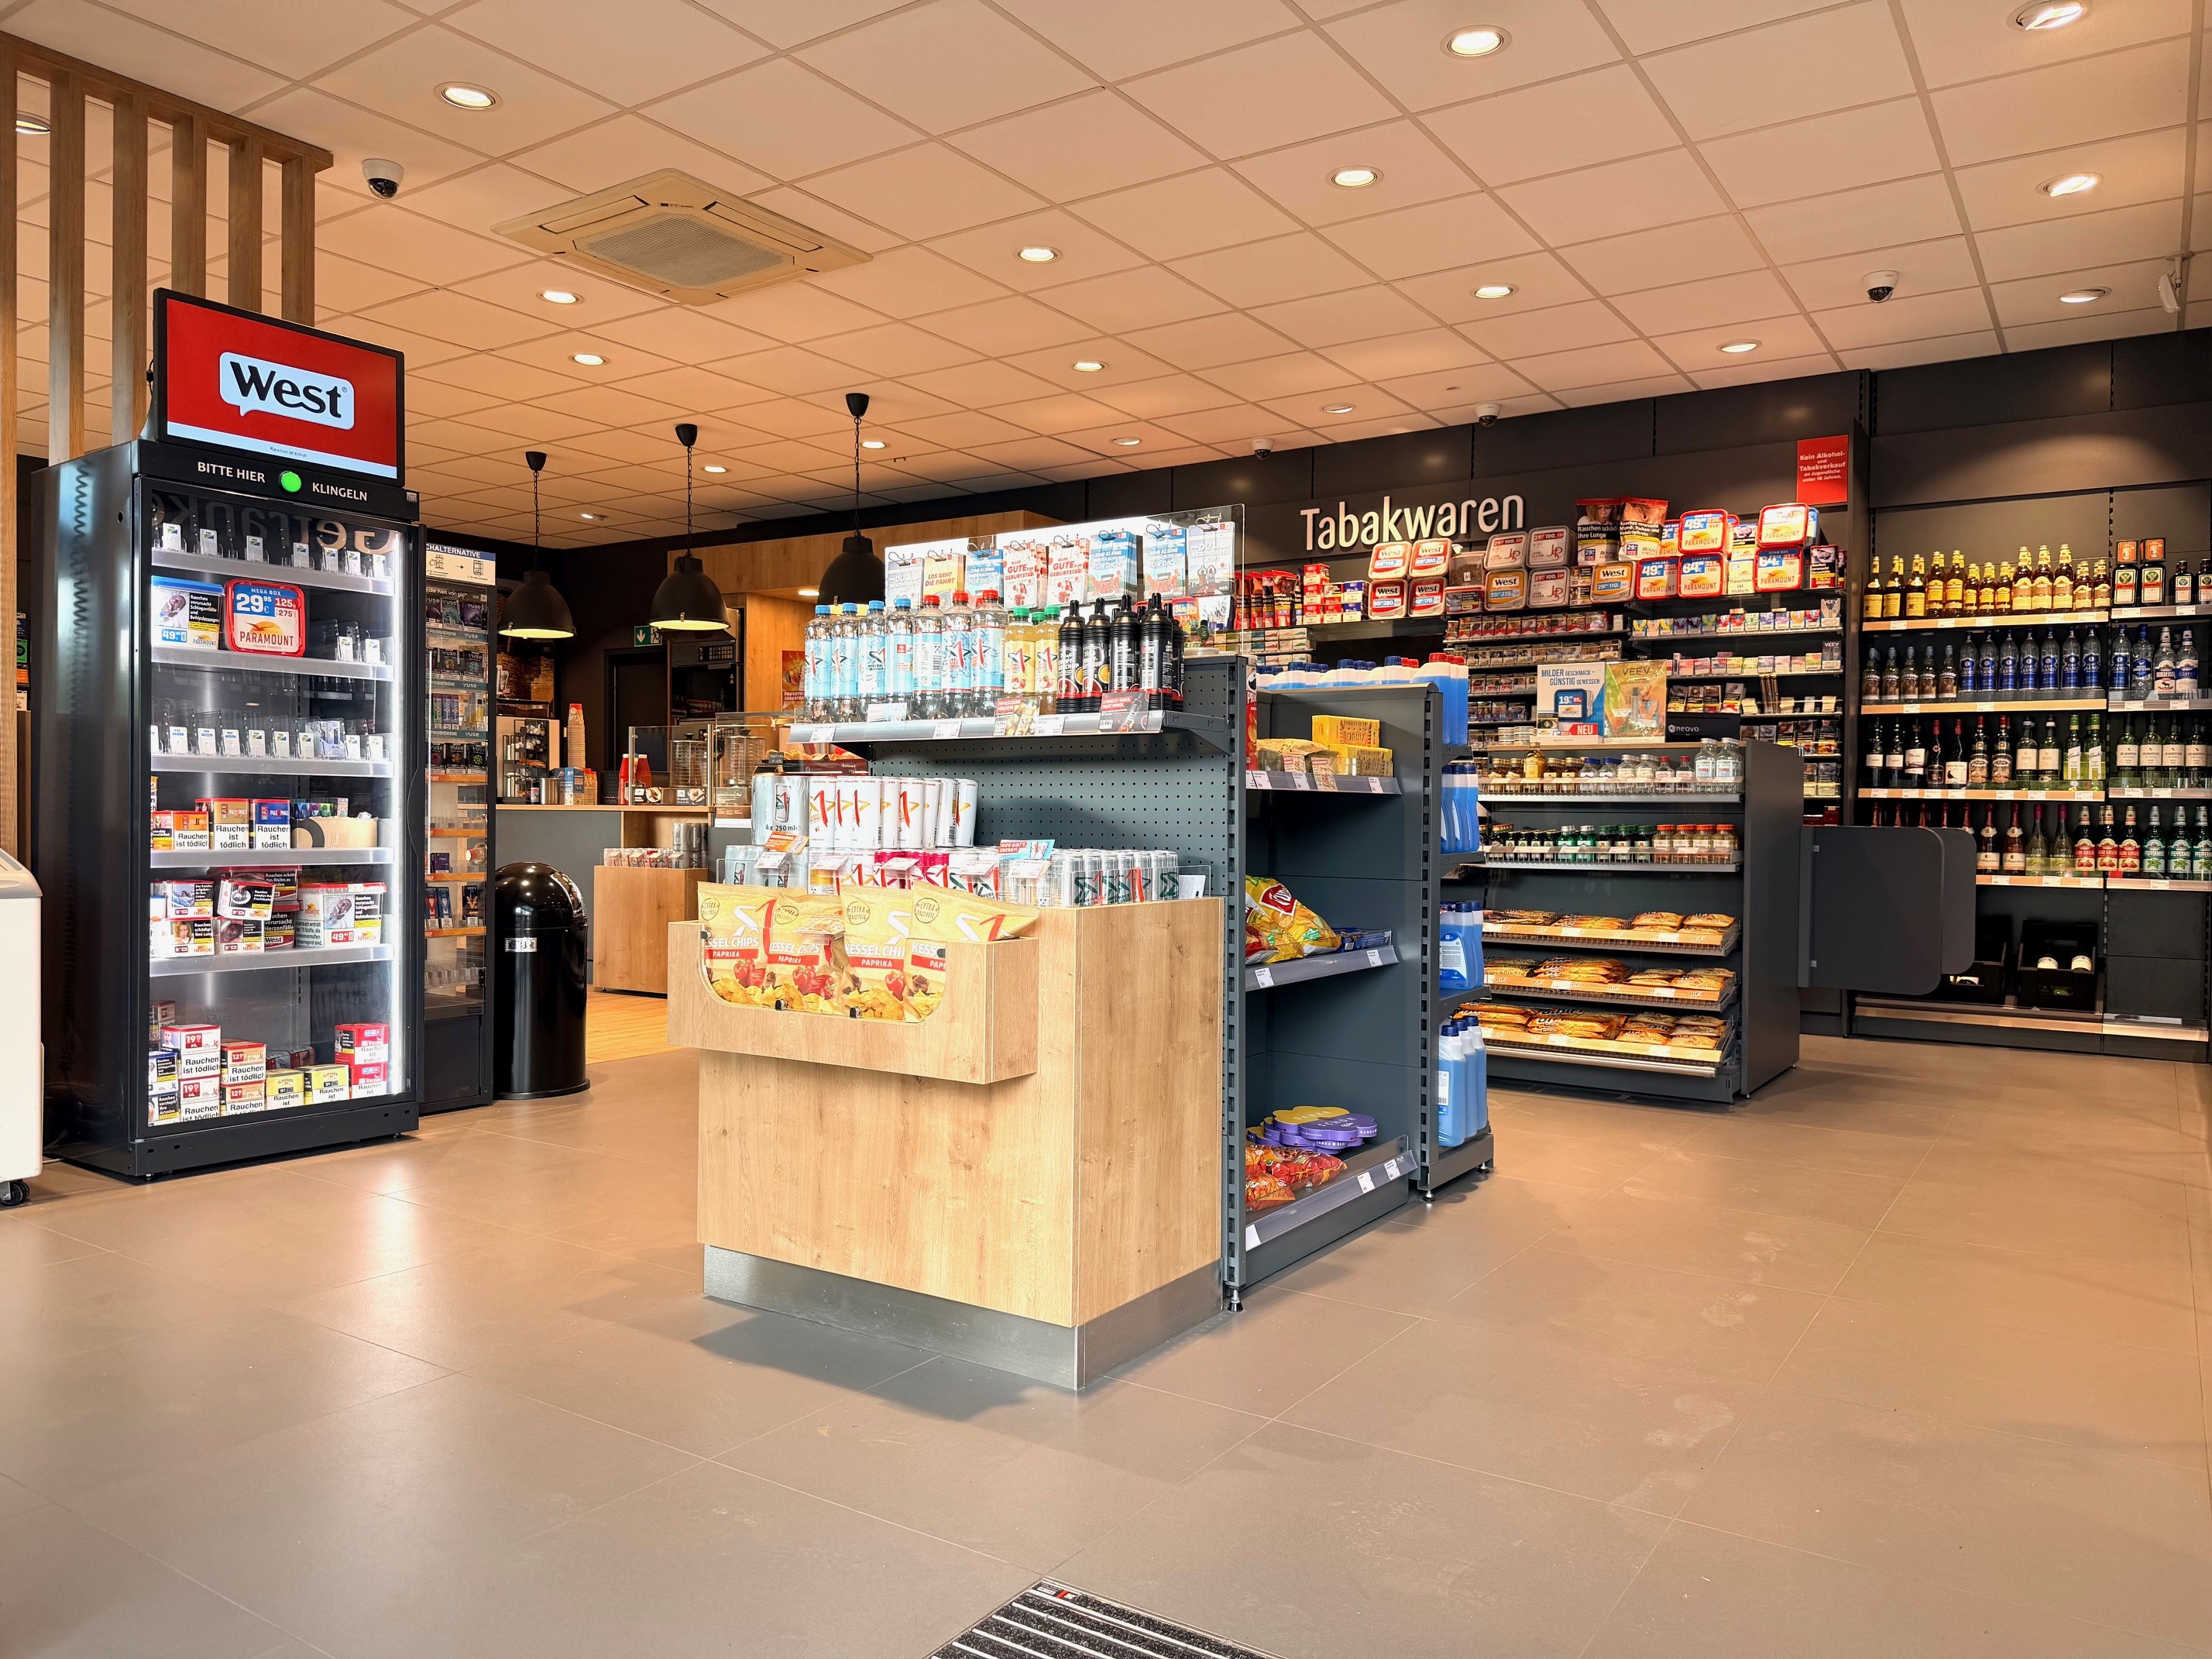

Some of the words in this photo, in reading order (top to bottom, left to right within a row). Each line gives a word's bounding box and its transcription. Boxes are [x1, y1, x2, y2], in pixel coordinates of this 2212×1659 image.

[230, 360, 342, 418] West
[1799, 462, 1845, 471] Tabakverkauf
[198, 462, 234, 477] BITTE
[236, 469, 266, 483] HIER
[312, 483, 368, 501] KLINGELN
[1300, 495, 1524, 551] Tabakwaren
[1764, 531, 1799, 539] PARAMOUNT
[1685, 538, 1718, 546] PARAMOUNT
[1008, 564, 1027, 573] GUTE
[1053, 561, 1074, 570] GUTE
[1682, 562, 1698, 573] 64
[1050, 568, 1083, 577] GEBURTSTAG!
[1642, 565, 1657, 576] 49
[1417, 585, 1437, 593] West
[1644, 585, 1674, 593] PARAMOUNT
[1684, 582, 1716, 591] PARAMOUNT
[240, 631, 294, 646] PARAMOUNT
[1541, 668, 1565, 677] MILDER
[1623, 667, 1650, 675] VEEV
[1550, 677, 1575, 686] GÜNSTIG
[1559, 696, 1568, 704] 19
[1577, 725, 1594, 735] NEU
[1676, 724, 1699, 733] neovo
[731, 938, 759, 947] CHIPS
[798, 943, 819, 954] CHIPS
[912, 942, 937, 953] KESS
[861, 959, 892, 967] PAPRIKA
[186, 1057, 218, 1066] Rauchen
[232, 1066, 263, 1074] Rauchen
[185, 1104, 218, 1115] Rauchen
[231, 1102, 263, 1111] Rauchen
[1293, 1111, 1331, 1120] DANKE
